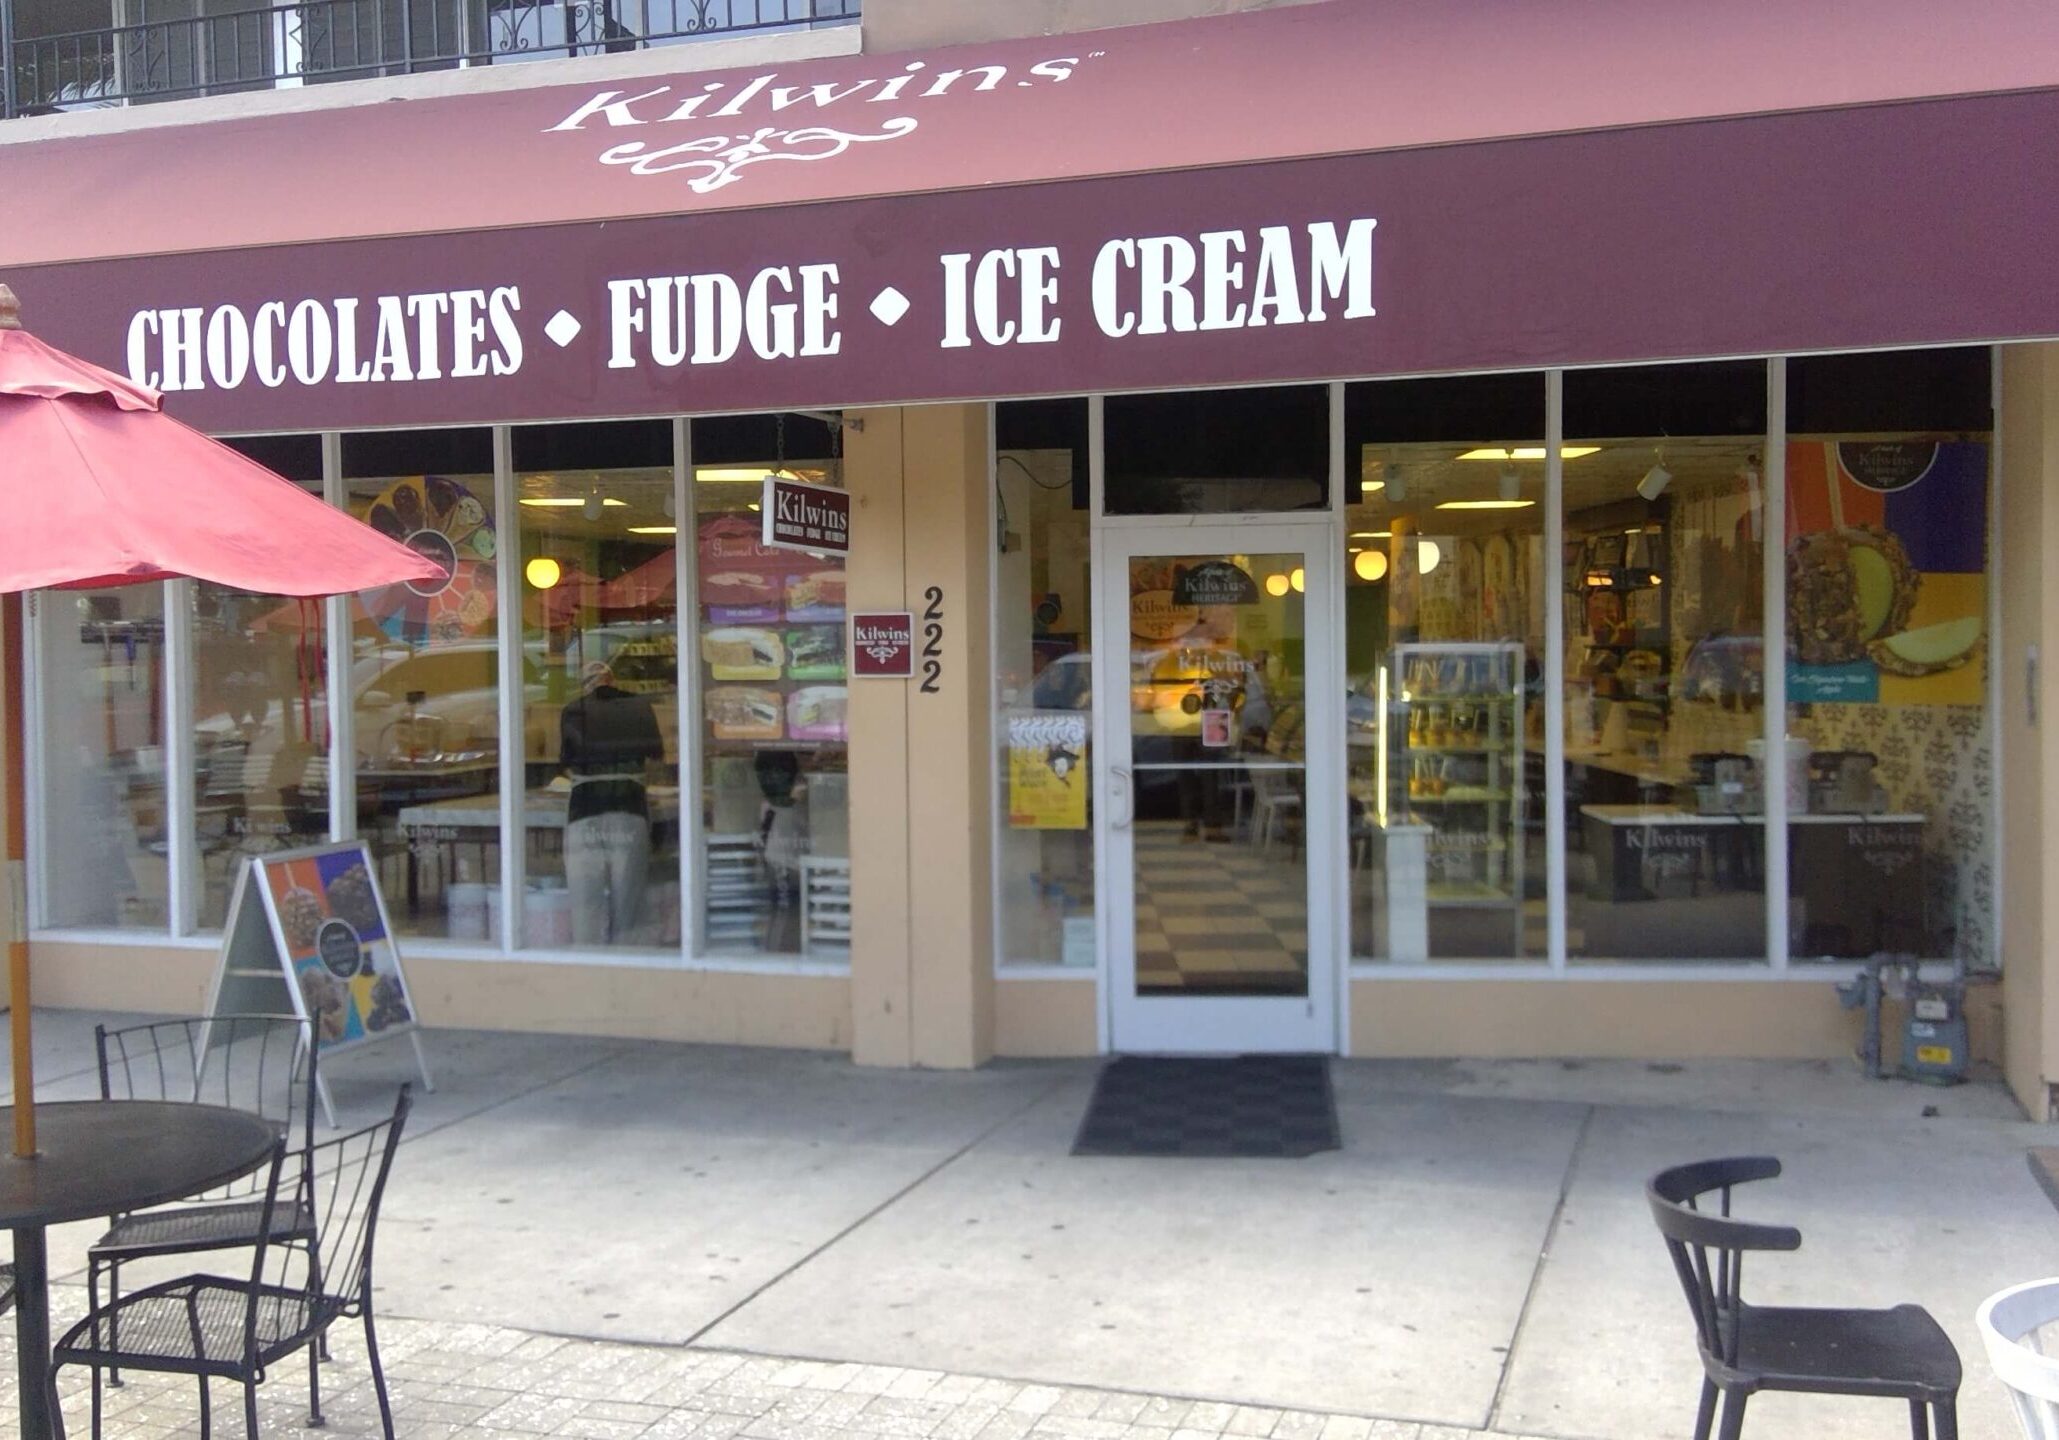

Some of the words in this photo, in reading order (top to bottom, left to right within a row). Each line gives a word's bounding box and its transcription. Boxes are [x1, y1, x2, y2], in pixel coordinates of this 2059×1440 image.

[541, 57, 1080, 133] Kilwins
[127, 286, 523, 391] CHOCOLATES
[607, 263, 841, 369] FUDGE
[940, 246, 1062, 350] ICE
[1091, 218, 1378, 338] CREAM
[776, 489, 847, 531] Kilwins
[856, 626, 909, 640] Kilwins
[1847, 826, 1921, 846] Kilwin
